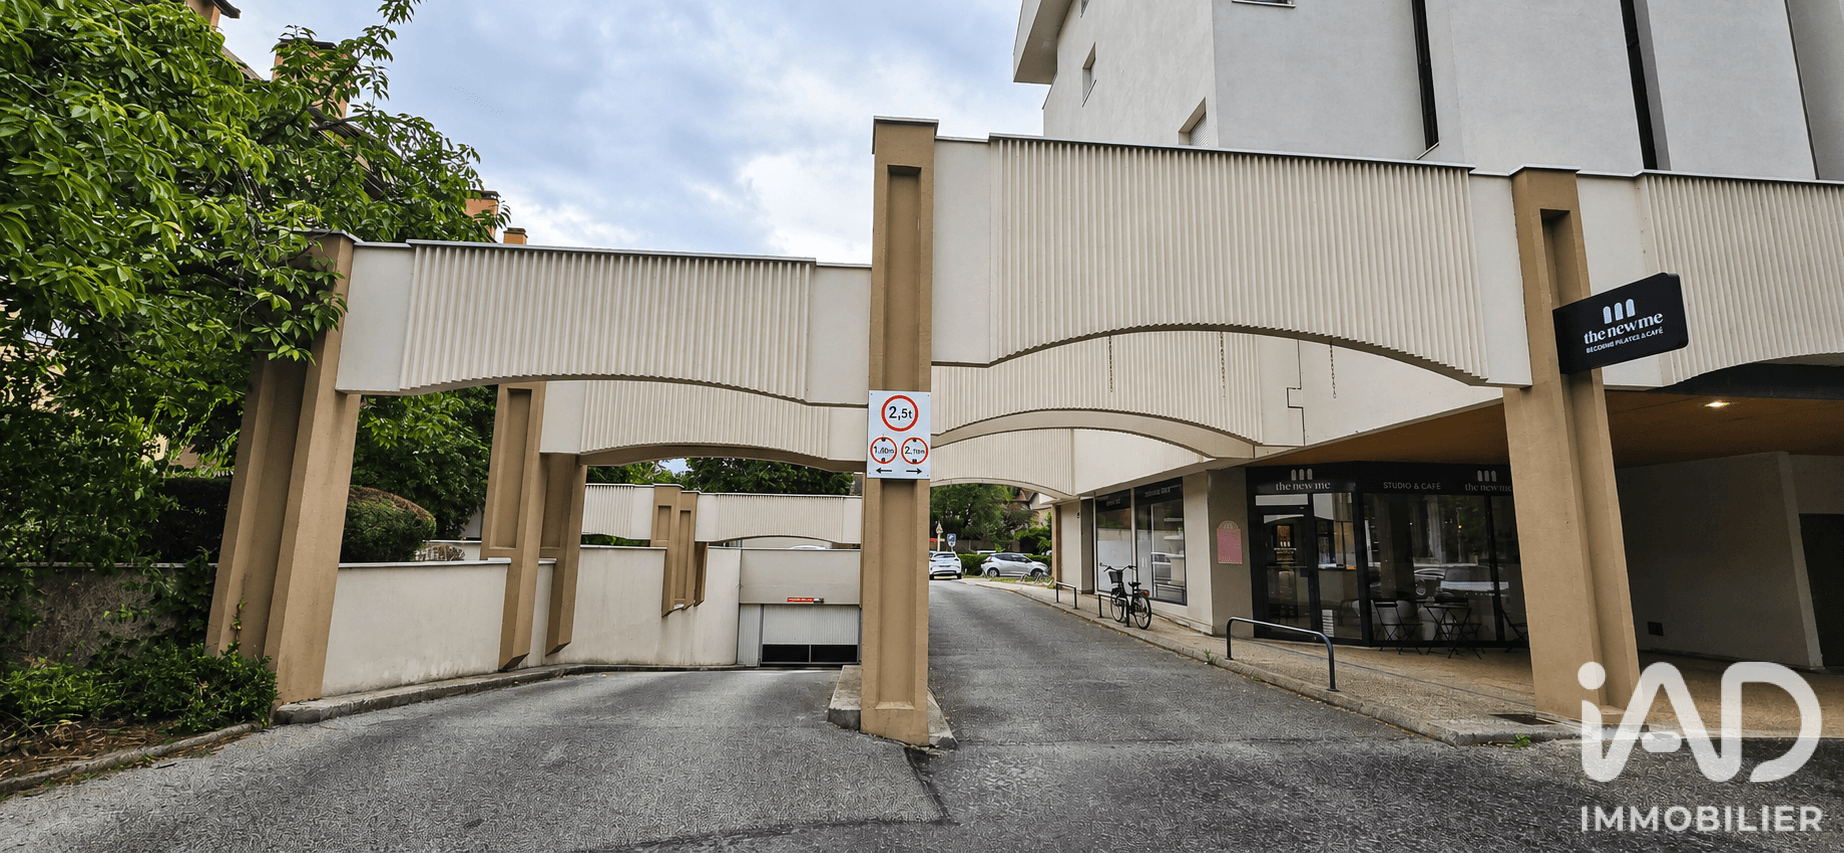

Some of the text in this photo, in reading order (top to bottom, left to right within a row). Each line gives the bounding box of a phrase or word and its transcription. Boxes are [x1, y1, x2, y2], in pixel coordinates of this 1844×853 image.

[1584, 331, 1606, 344] the
[1275, 481, 1331, 491] the new me
[1383, 481, 1441, 490] STUDIO & CAFÉ
[1464, 483, 1479, 492] the
[1480, 484, 1499, 492] new
